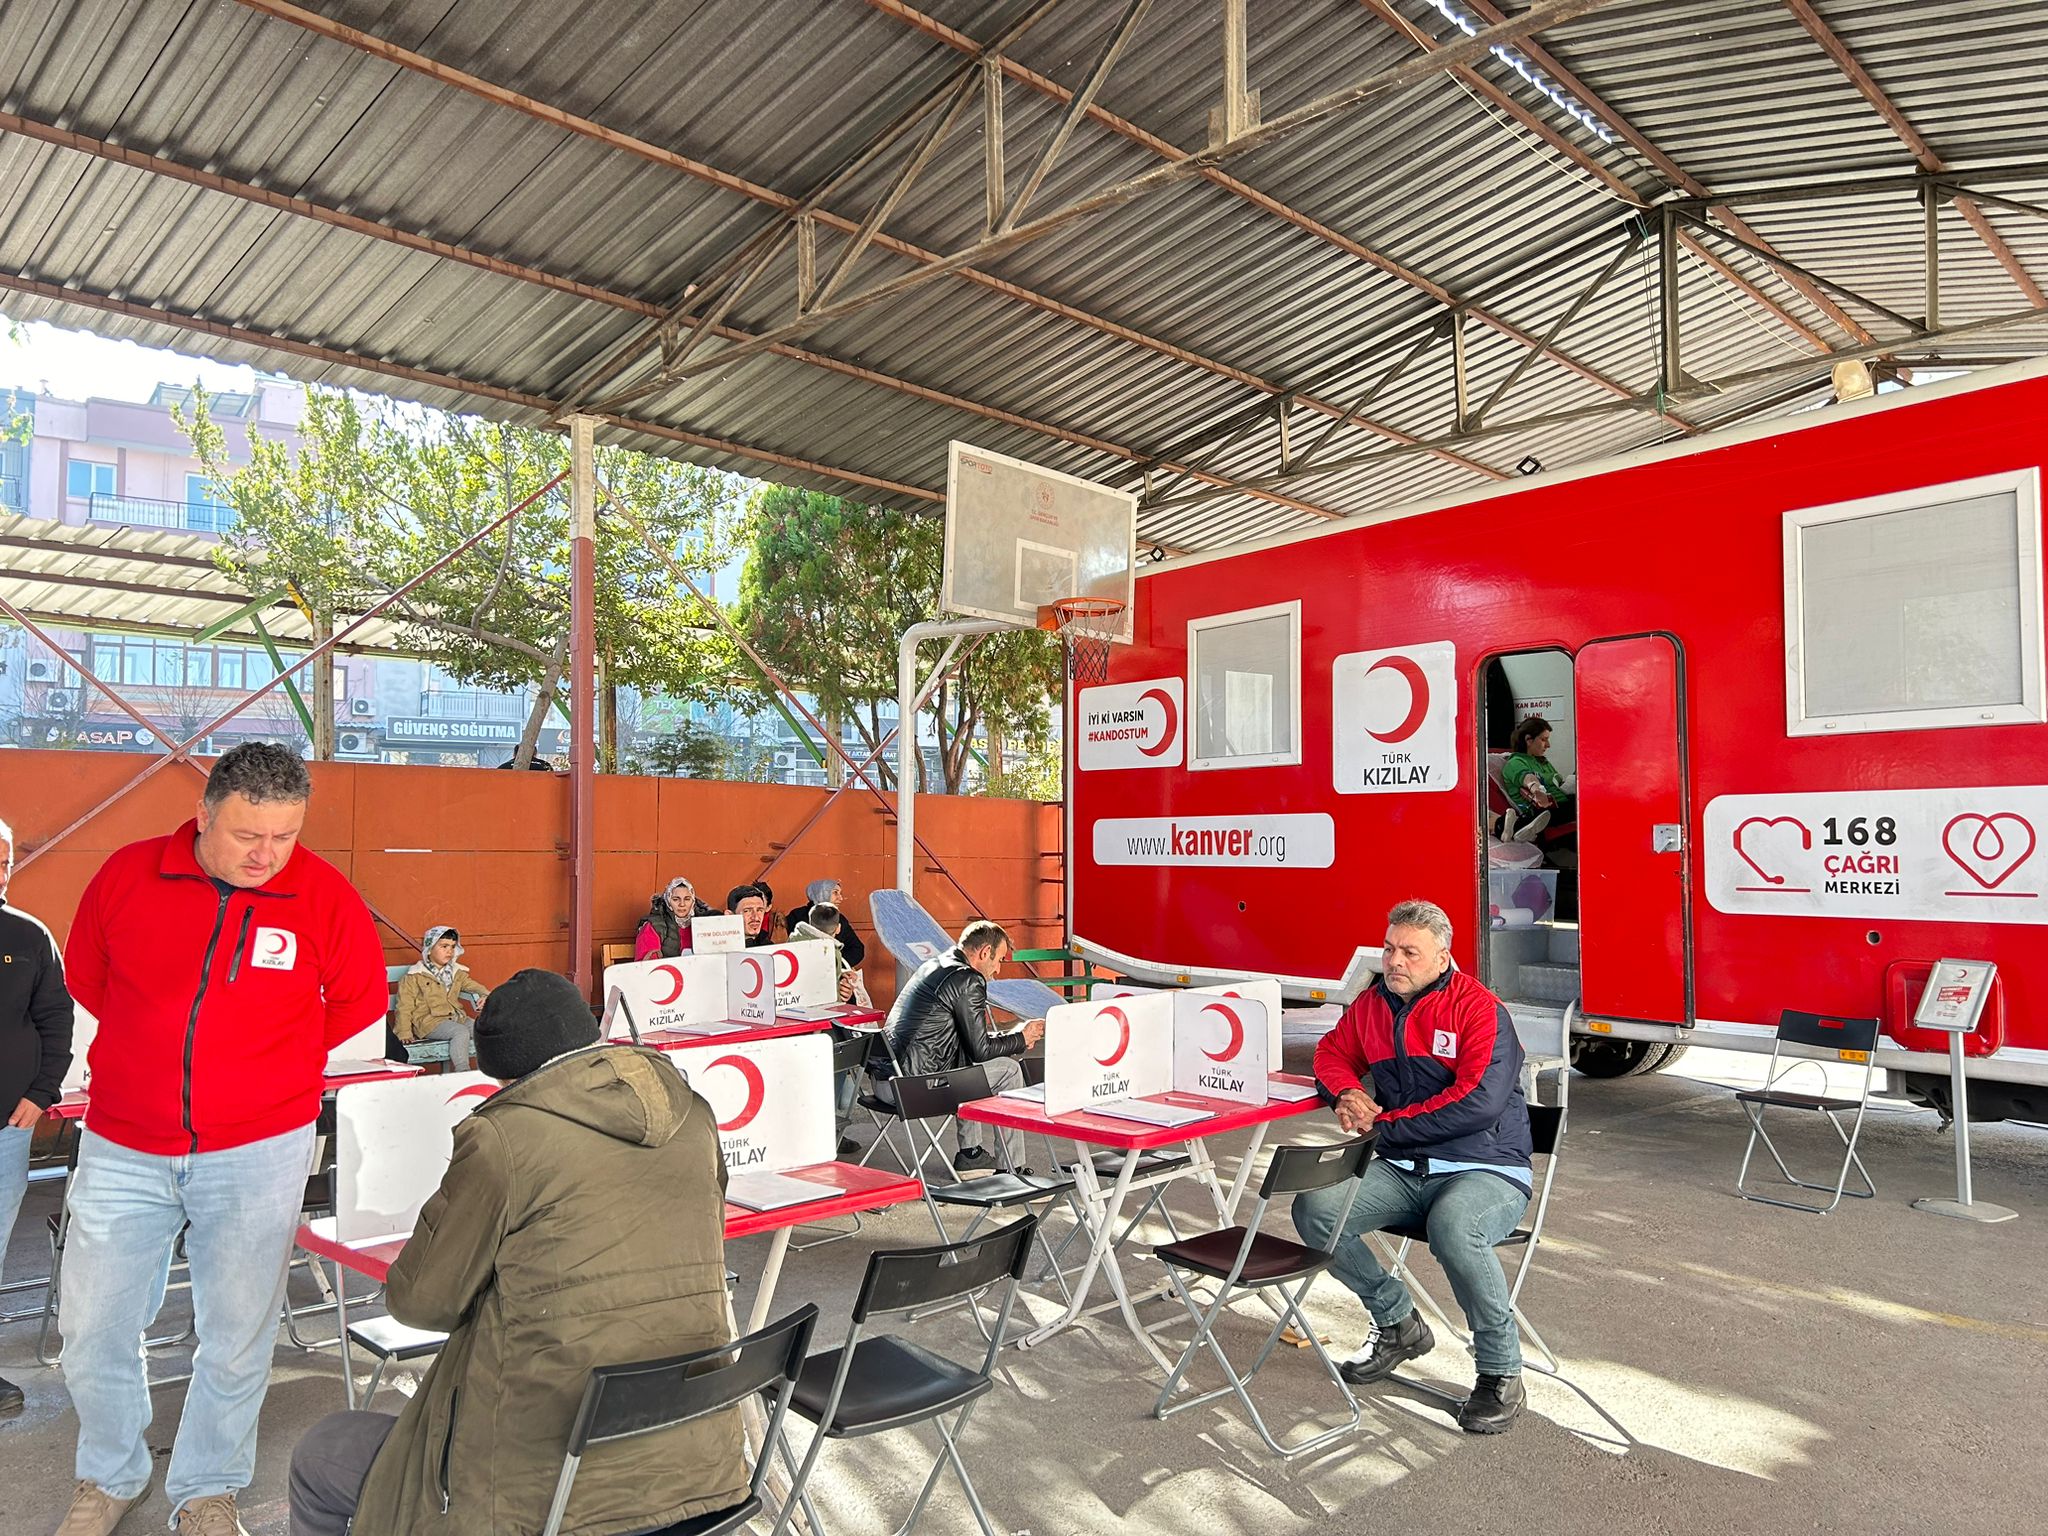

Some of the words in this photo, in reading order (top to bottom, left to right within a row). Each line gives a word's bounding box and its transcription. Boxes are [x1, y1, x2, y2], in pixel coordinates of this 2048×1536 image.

[1088, 712, 1100, 725] İYİ
[1101, 710, 1110, 724] Kİ
[1111, 710, 1144, 724] VARSIN
[393, 720, 448, 738] GÜVENÇ
[450, 721, 516, 738] SOĞUTMA
[1088, 727, 1149, 742] #KANDOSTUM
[1381, 752, 1412, 765] TÜRK
[1363, 766, 1431, 786] KIZILAY
[1822, 816, 1898, 847] 168
[1127, 823, 1286, 862] www.kanver.org
[1823, 850, 1900, 878] ÇAĞRI
[1824, 878, 1900, 895] MERKEZİ
[775, 995, 801, 1007] IZILAY
[649, 1013, 686, 1027] KIZILAY
[740, 1008, 765, 1019] KIZILAY
[1103, 1072, 1120, 1081] TÜRK
[1211, 1067, 1232, 1077] TÜRK
[1092, 1079, 1130, 1097] KIZILAY
[1199, 1075, 1245, 1093] KIZILAY
[722, 1138, 750, 1150] TÜRK
[722, 1146, 767, 1168] ZILAY
